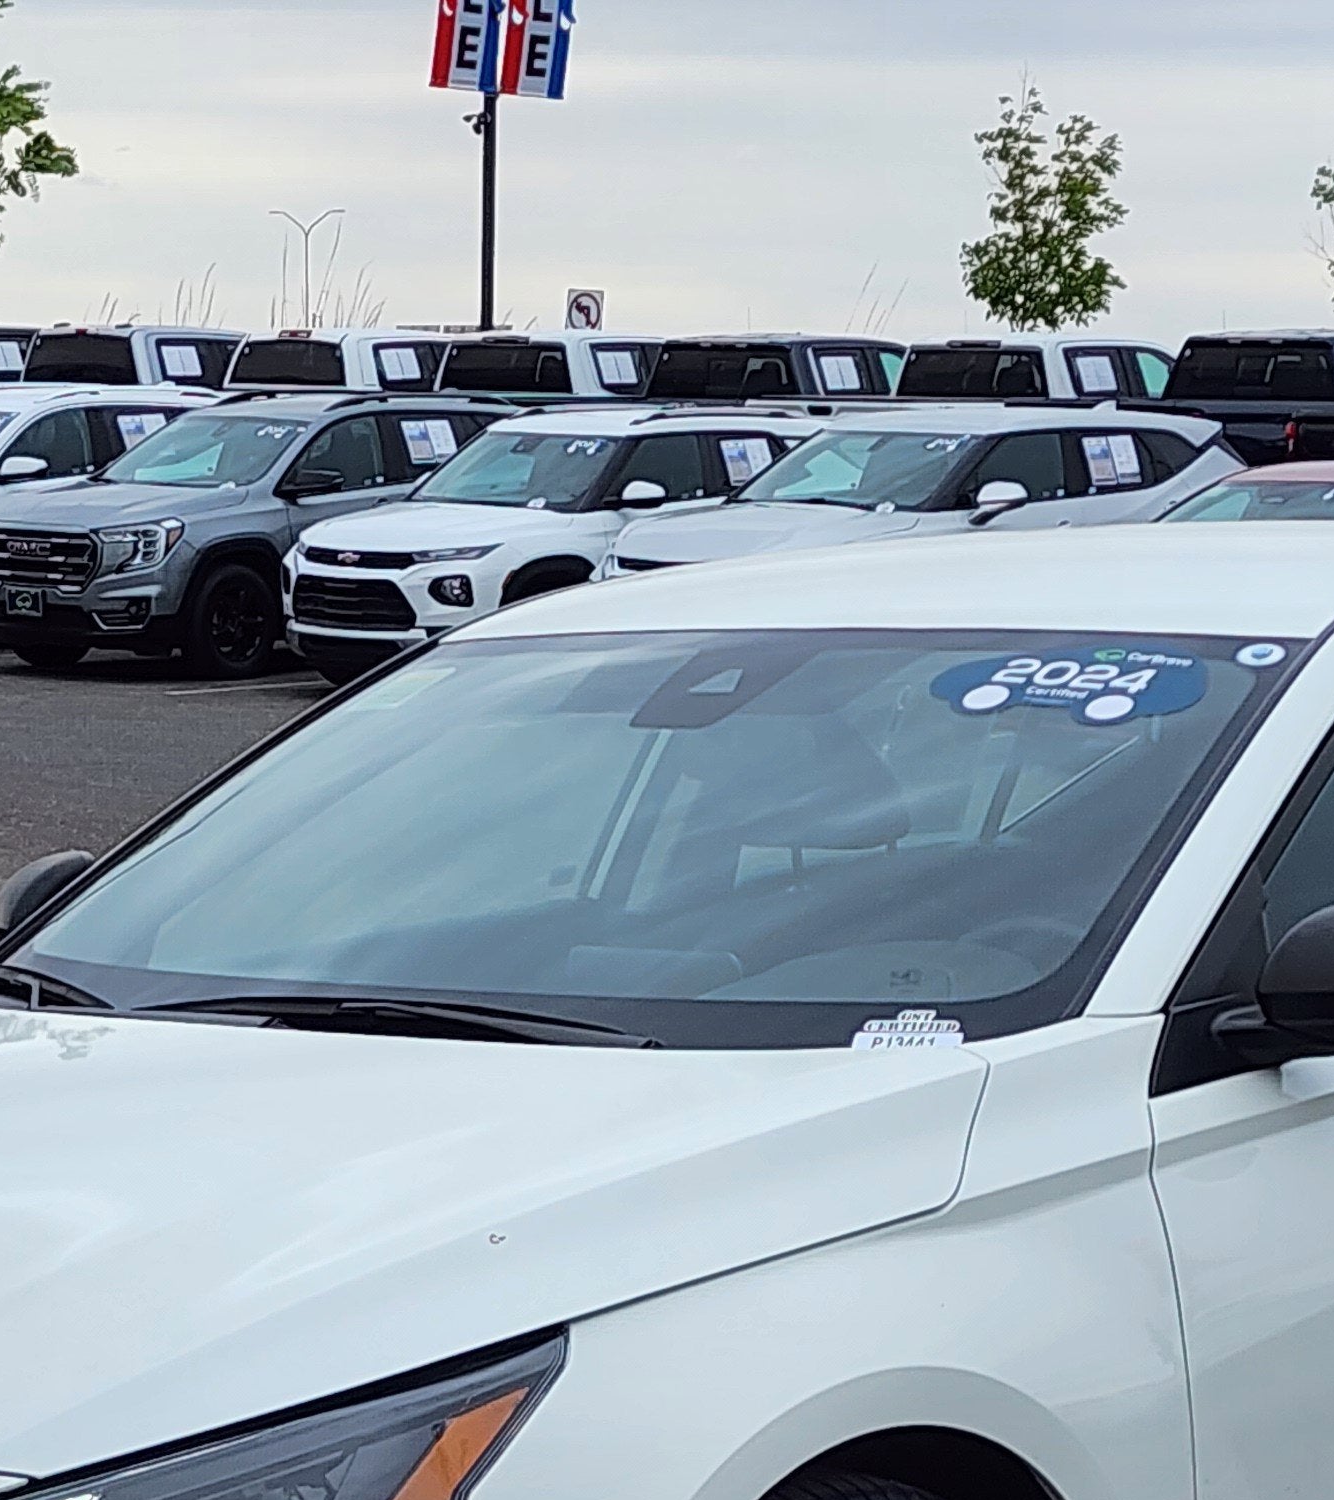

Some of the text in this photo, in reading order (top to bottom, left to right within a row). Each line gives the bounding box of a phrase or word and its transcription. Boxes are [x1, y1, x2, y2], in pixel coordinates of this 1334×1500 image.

[6, 541, 51, 556] GMC
[991, 658, 1158, 694] 2024
[1025, 685, 1089, 699] Certified
